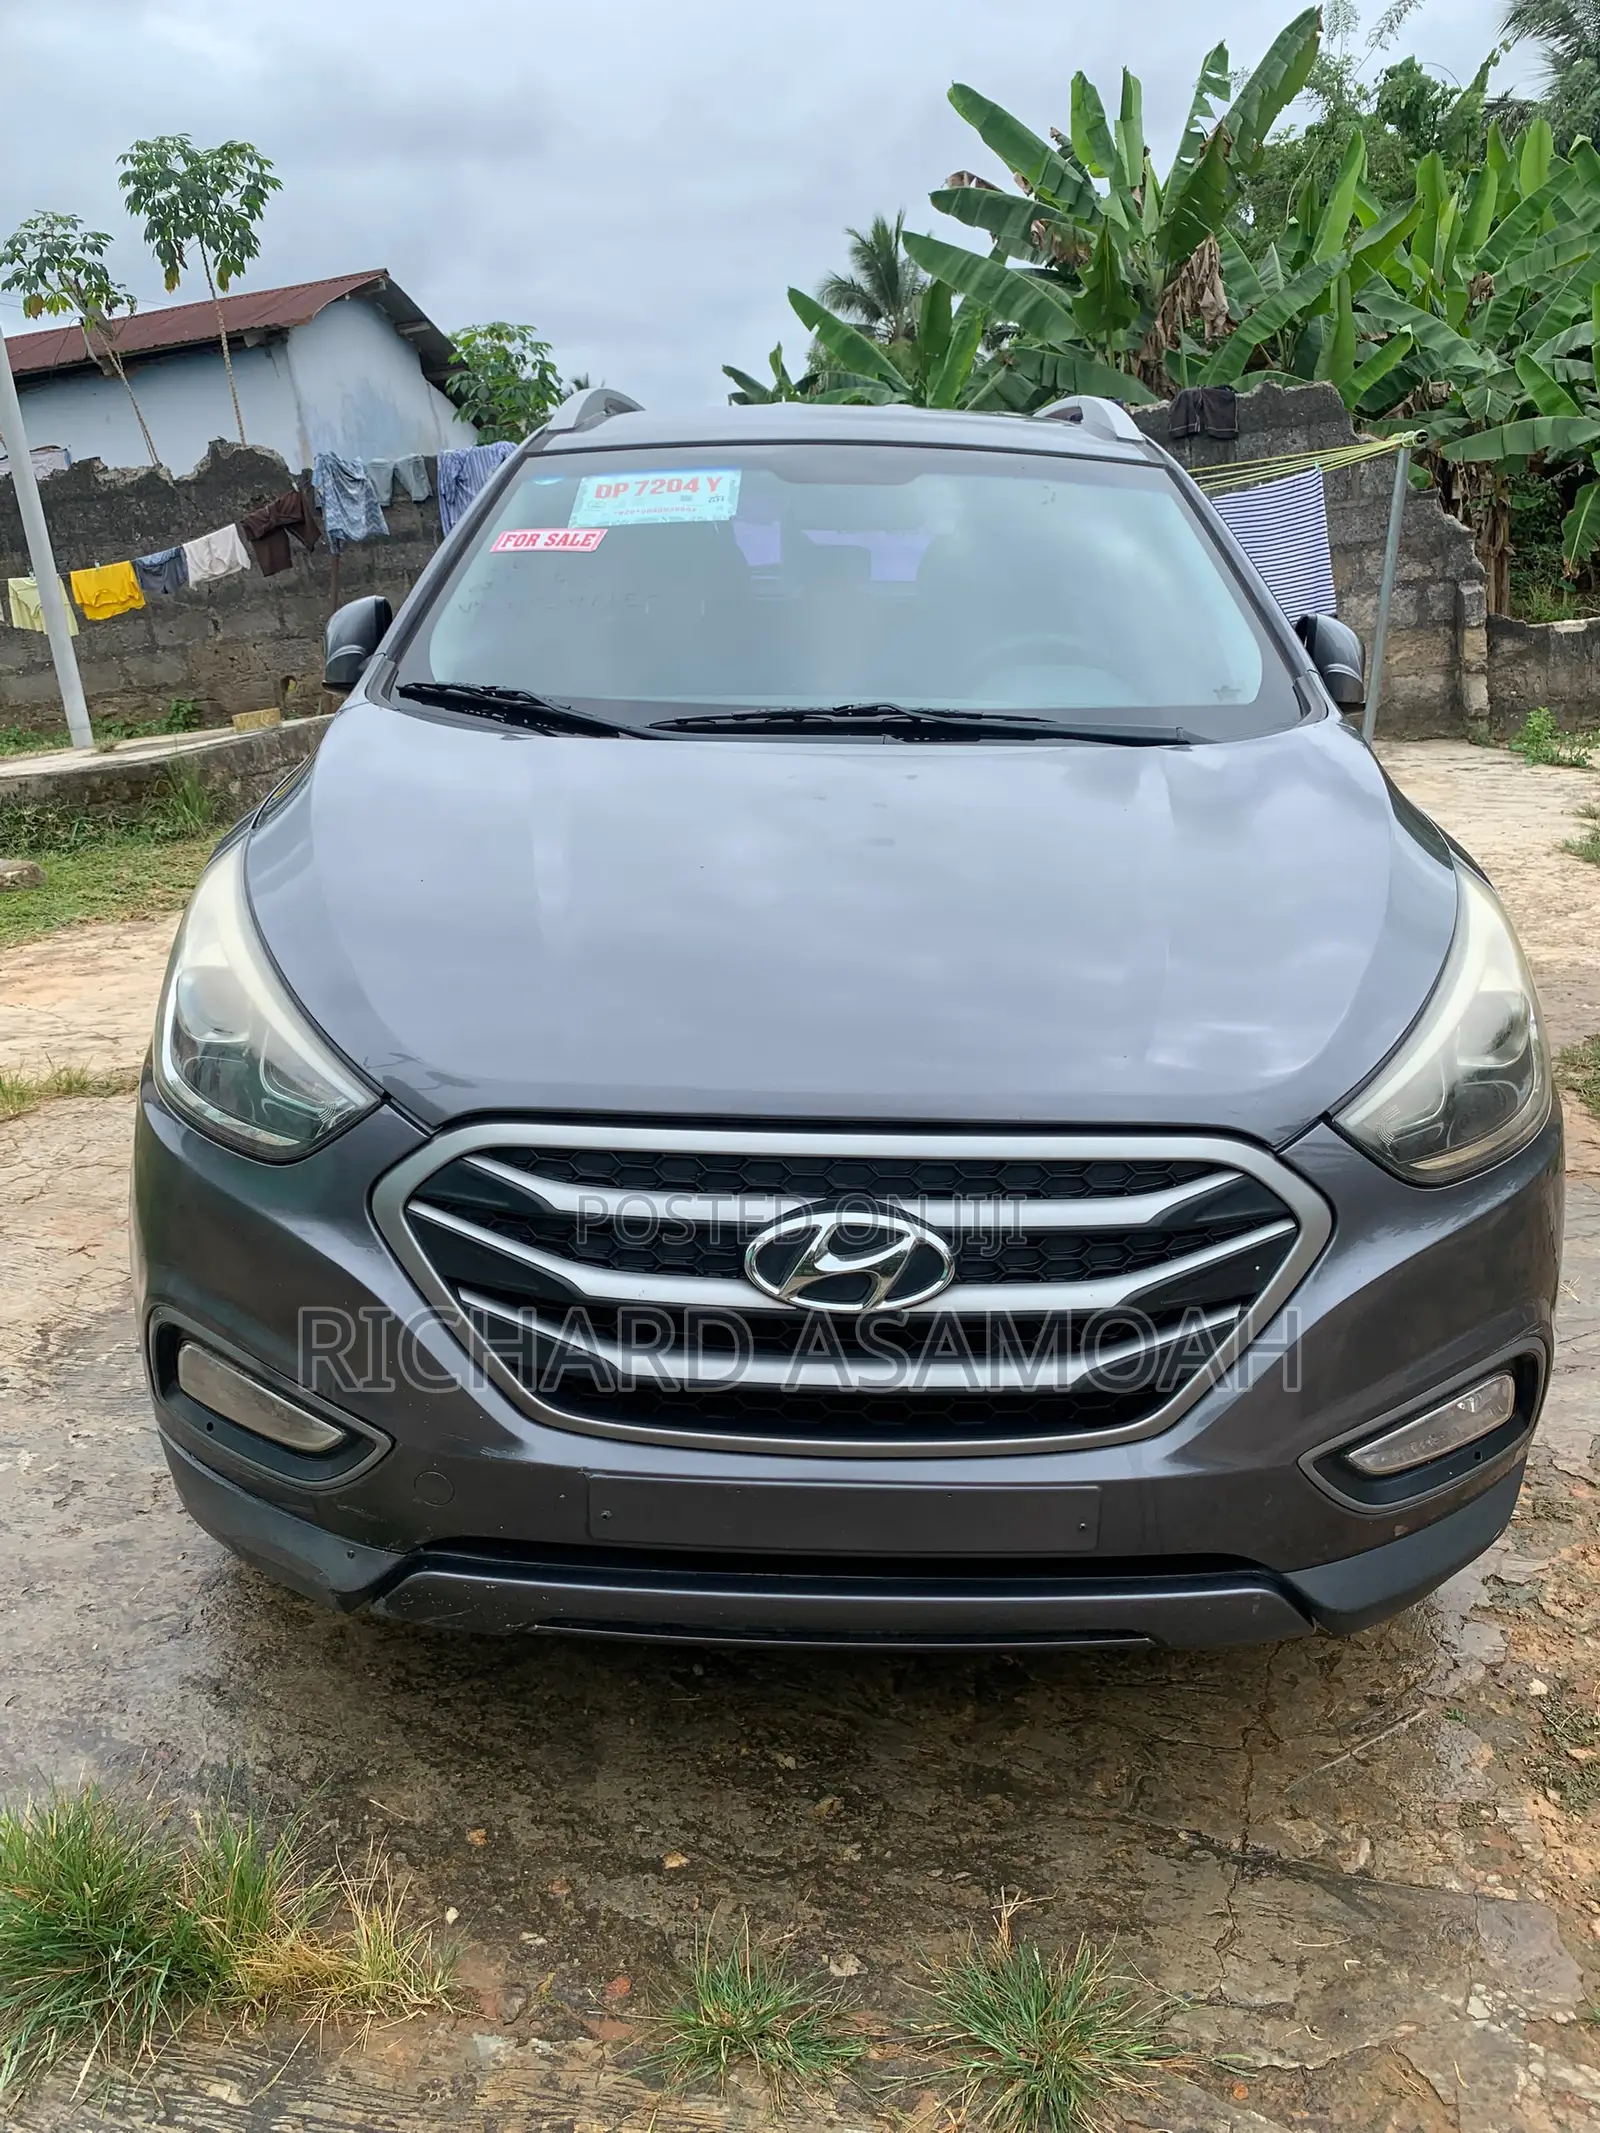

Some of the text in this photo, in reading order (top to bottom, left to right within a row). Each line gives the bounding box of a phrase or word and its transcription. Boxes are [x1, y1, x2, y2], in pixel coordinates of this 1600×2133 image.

[594, 476, 723, 499] DP 7204 Y
[501, 533, 597, 548] FOR SALE
